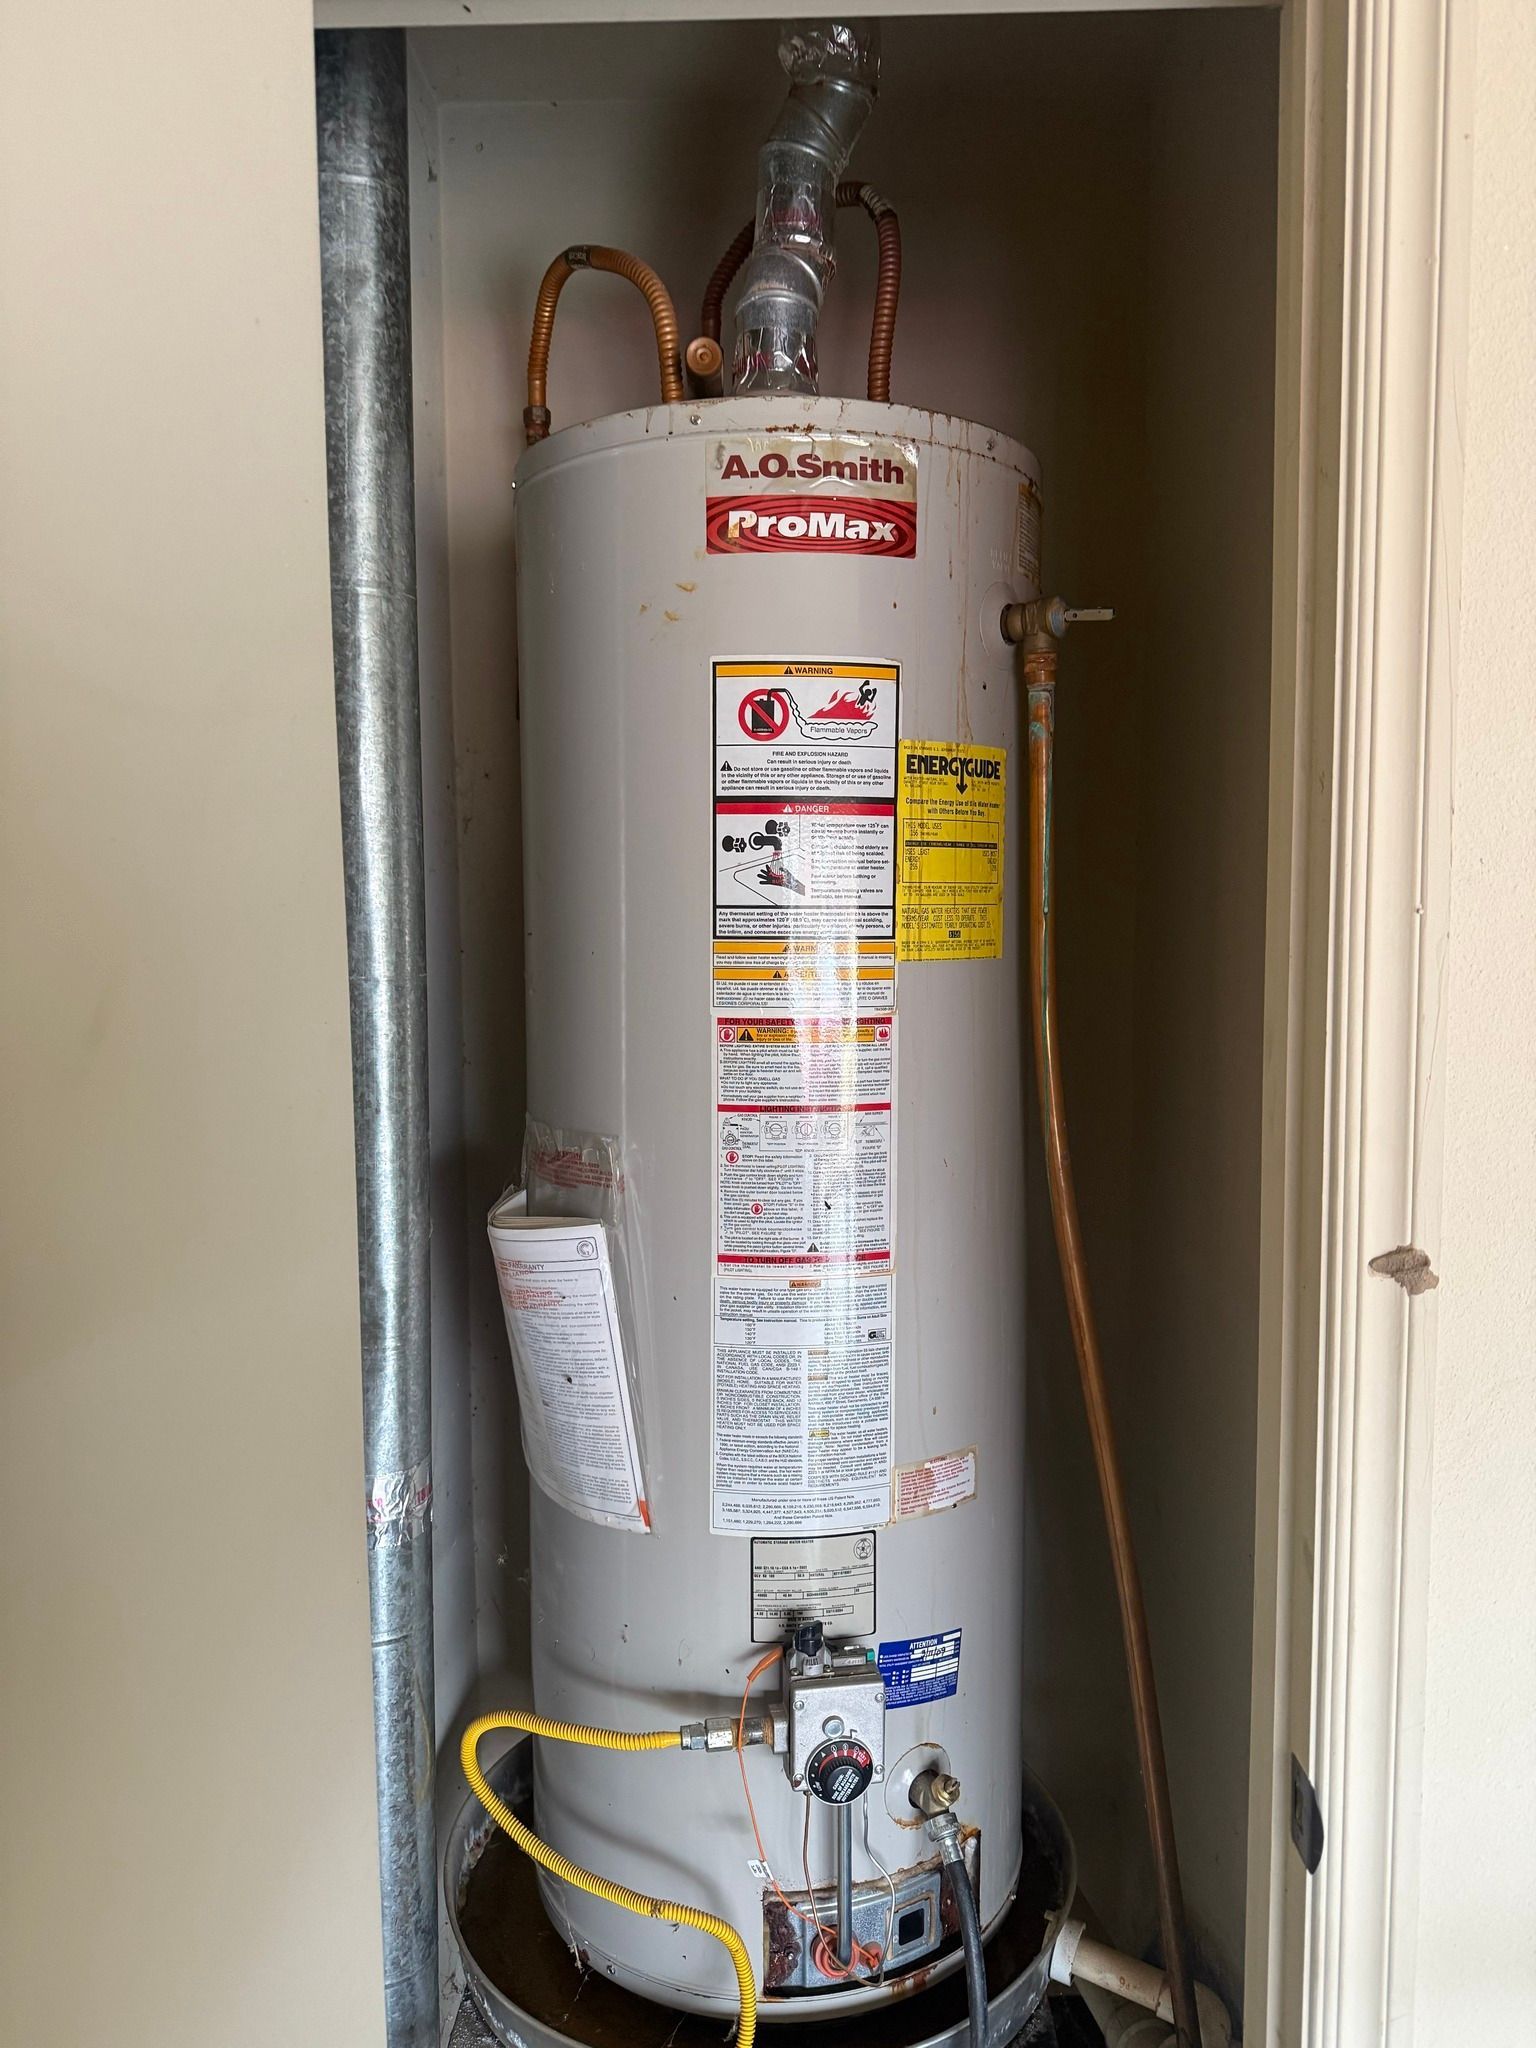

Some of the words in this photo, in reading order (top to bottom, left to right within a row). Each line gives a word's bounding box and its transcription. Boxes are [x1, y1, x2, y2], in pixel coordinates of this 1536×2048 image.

[721, 453, 904, 484] A.O.Smith
[728, 510, 896, 542] ProMax
[795, 666, 833, 675] WARNING
[810, 726, 845, 734] Flammable
[846, 726, 868, 734] Vapors
[906, 754, 1001, 780] ENERGYGUIDE
[906, 797, 928, 807] Compare
[929, 798, 938, 806] the
[939, 799, 955, 808] Energy
[795, 805, 829, 813] DANGER
[909, 1638, 938, 1650] ATTENTION
